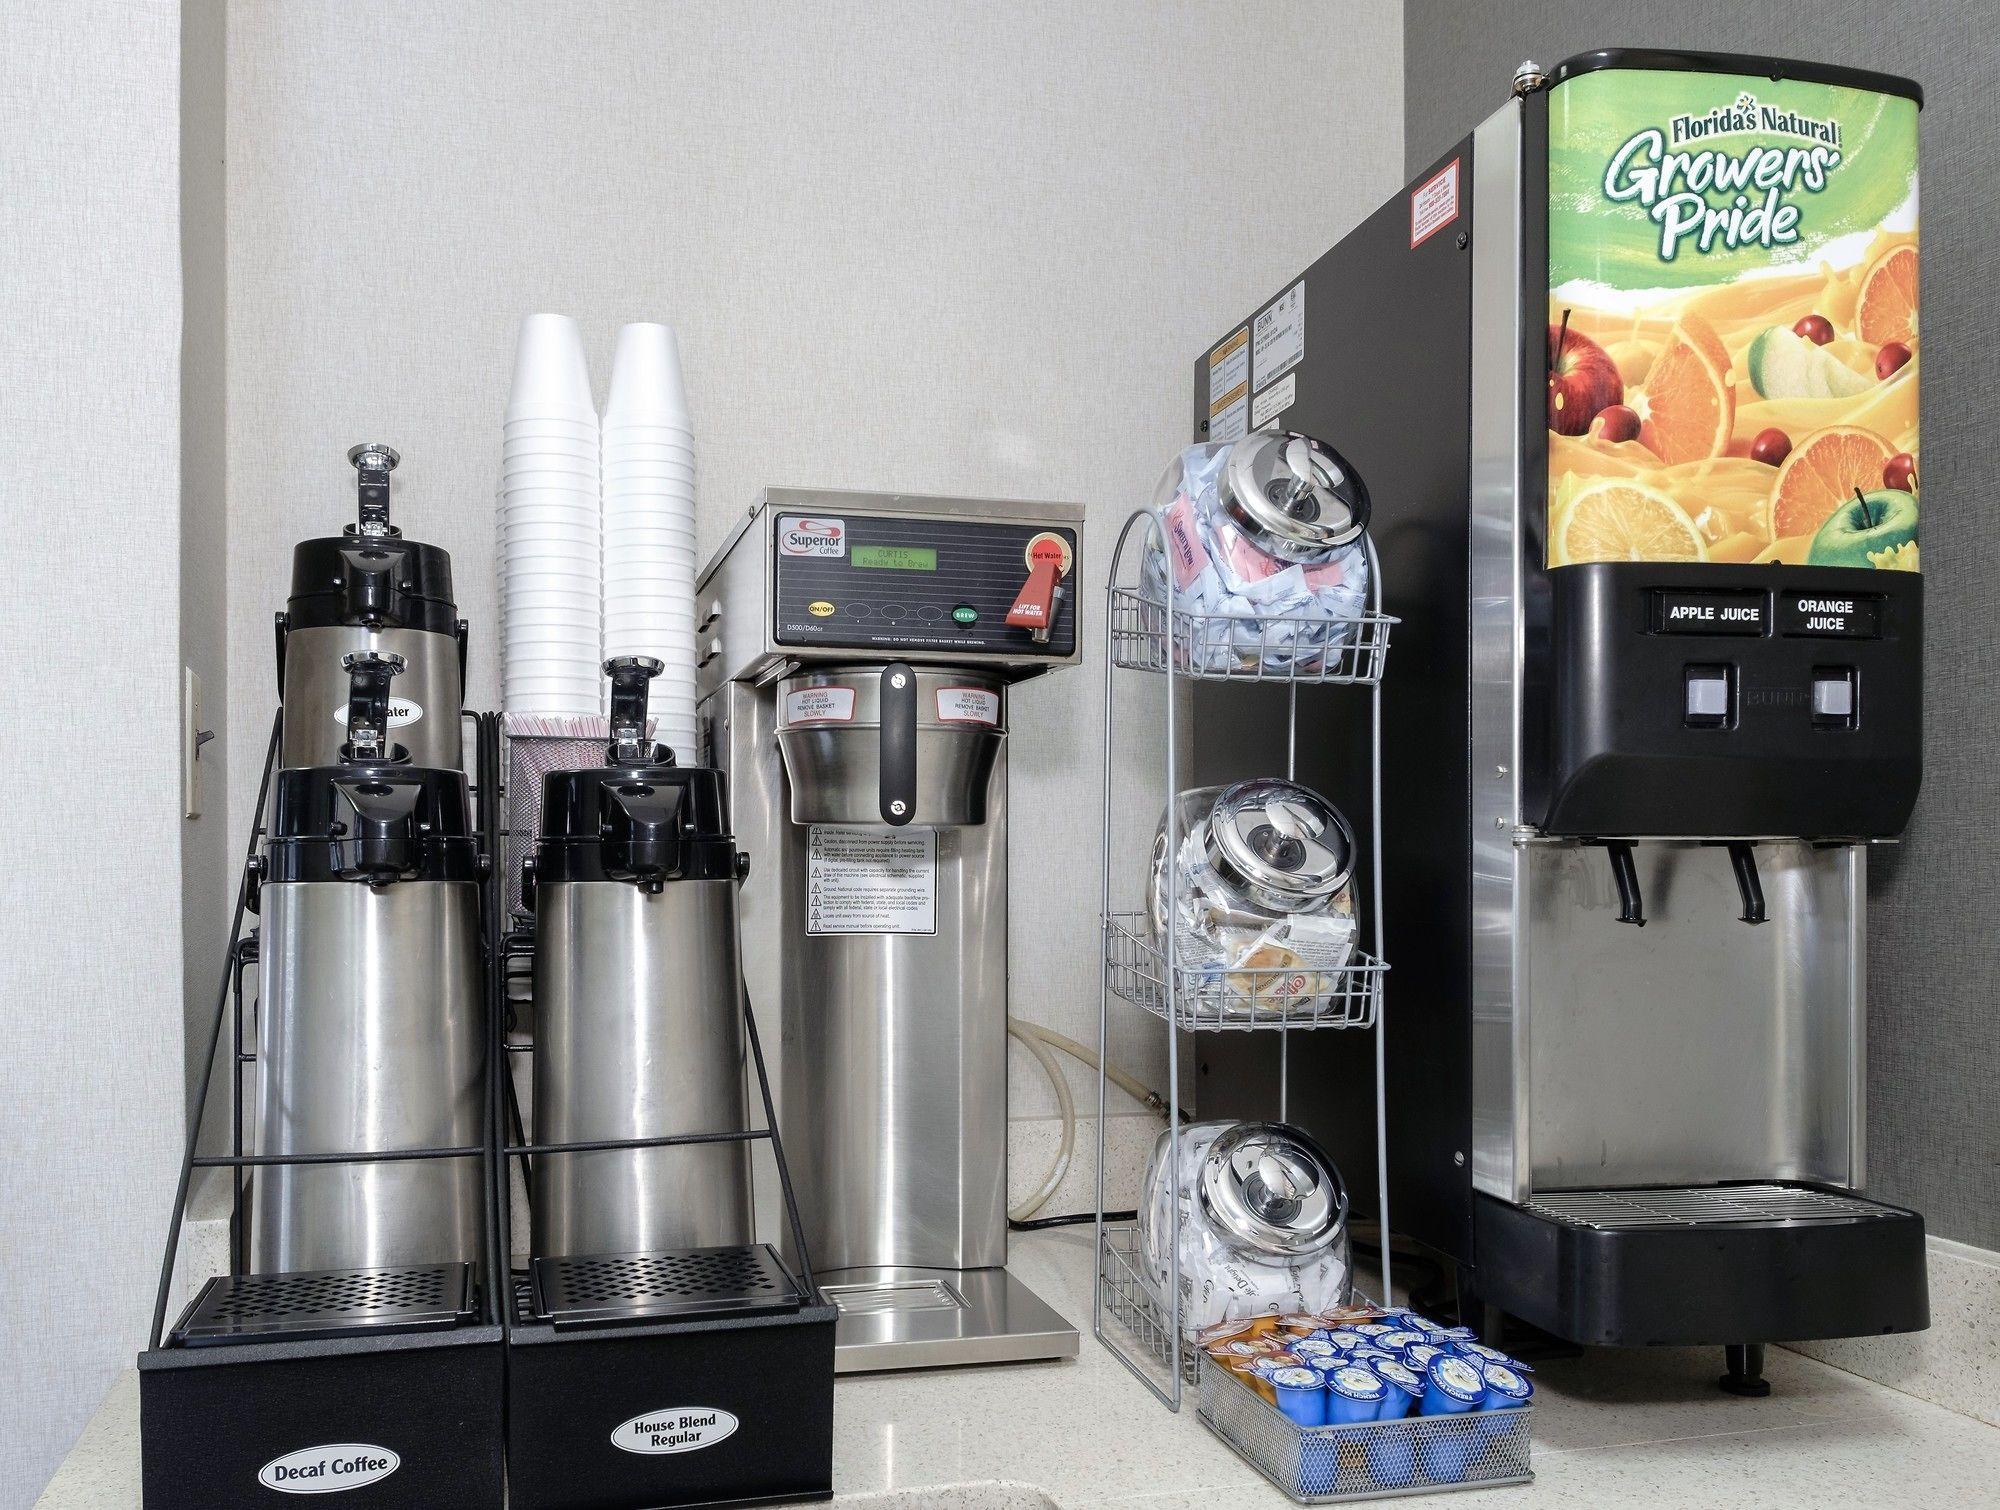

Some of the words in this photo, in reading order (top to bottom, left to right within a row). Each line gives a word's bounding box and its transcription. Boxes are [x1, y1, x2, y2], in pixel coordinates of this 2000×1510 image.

[1761, 106, 1838, 144] Natural
[1652, 188, 1799, 260] Pride
[1257, 312, 1273, 332] BUNN
[790, 533, 841, 548] Superior
[820, 546, 838, 554] Coffee
[1033, 552, 1043, 560] Hot
[863, 557, 888, 567] Ready
[893, 559, 904, 567] to
[1670, 606, 1714, 620] APPLE
[1720, 608, 1760, 621] JUICE
[1798, 600, 1854, 614] ORANGE
[1806, 617, 1844, 630] JUICE
[962, 692, 986, 700] WARNING
[386, 706, 410, 717] ater
[1353, 1392, 1380, 1400] FRENCH
[1446, 1388, 1474, 1400] FRENCH
[634, 1418, 674, 1434] House
[678, 1414, 716, 1430] Blend
[650, 1430, 702, 1448] Regular
[274, 1460, 327, 1482] Decaf
[331, 1455, 388, 1478] Coffee
